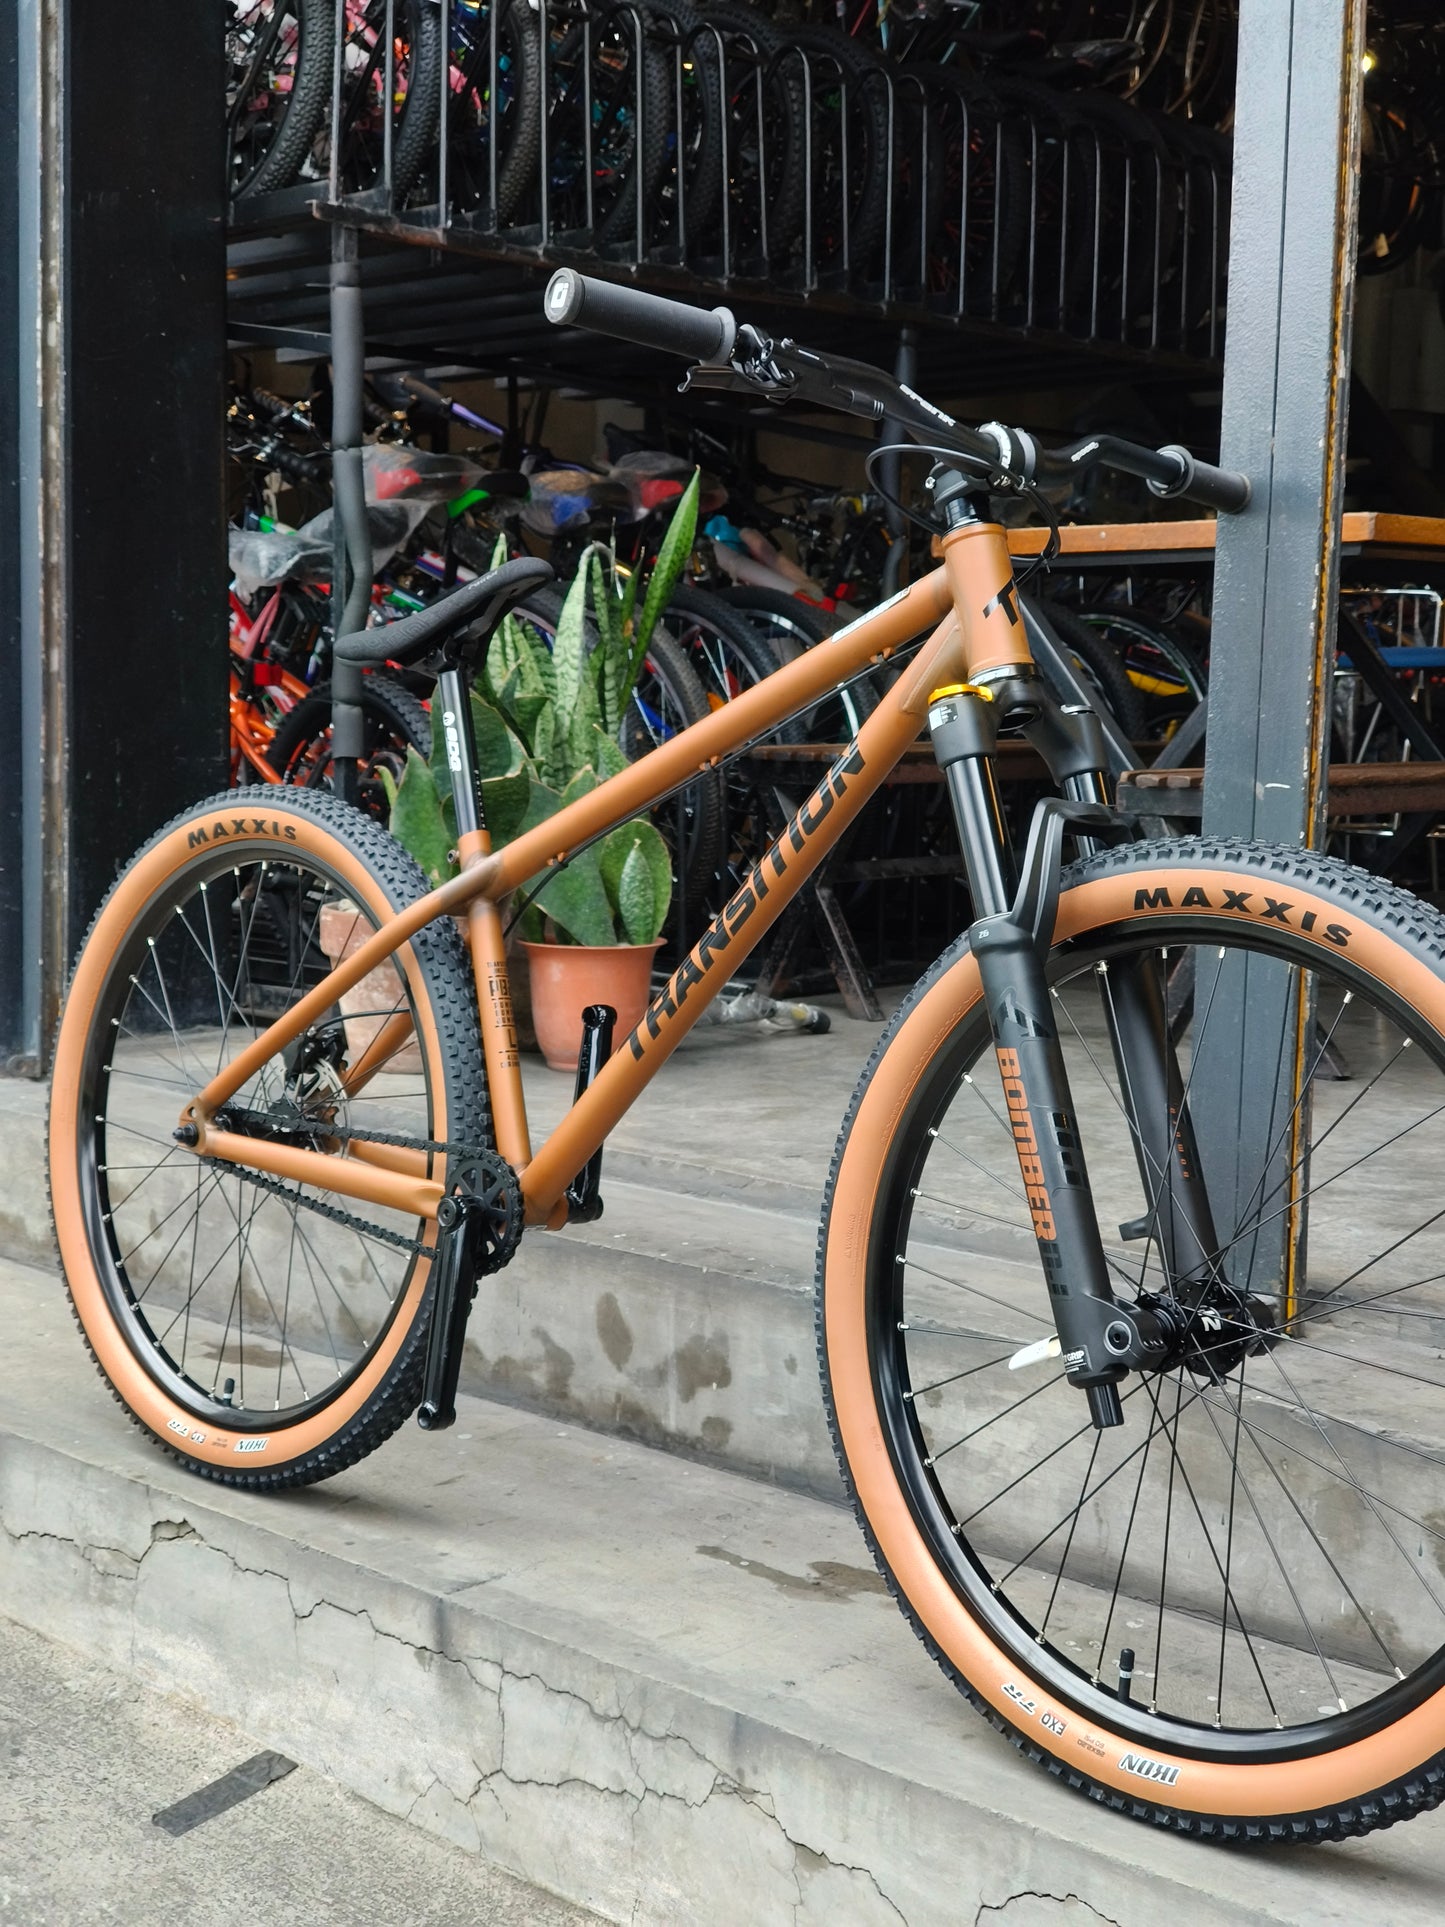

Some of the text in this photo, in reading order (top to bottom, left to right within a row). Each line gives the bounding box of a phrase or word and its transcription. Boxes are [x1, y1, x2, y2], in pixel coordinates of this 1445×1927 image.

[187, 819, 297, 849] MAXXIS
[617, 735, 866, 1061] TRANSITION
[1134, 887, 1353, 947] MAXXIS
[997, 1048, 1057, 1241] BOMBER
[1003, 1684, 1036, 1714] TR
[1041, 1712, 1067, 1736] EXO
[1120, 1754, 1180, 1784] IKON
